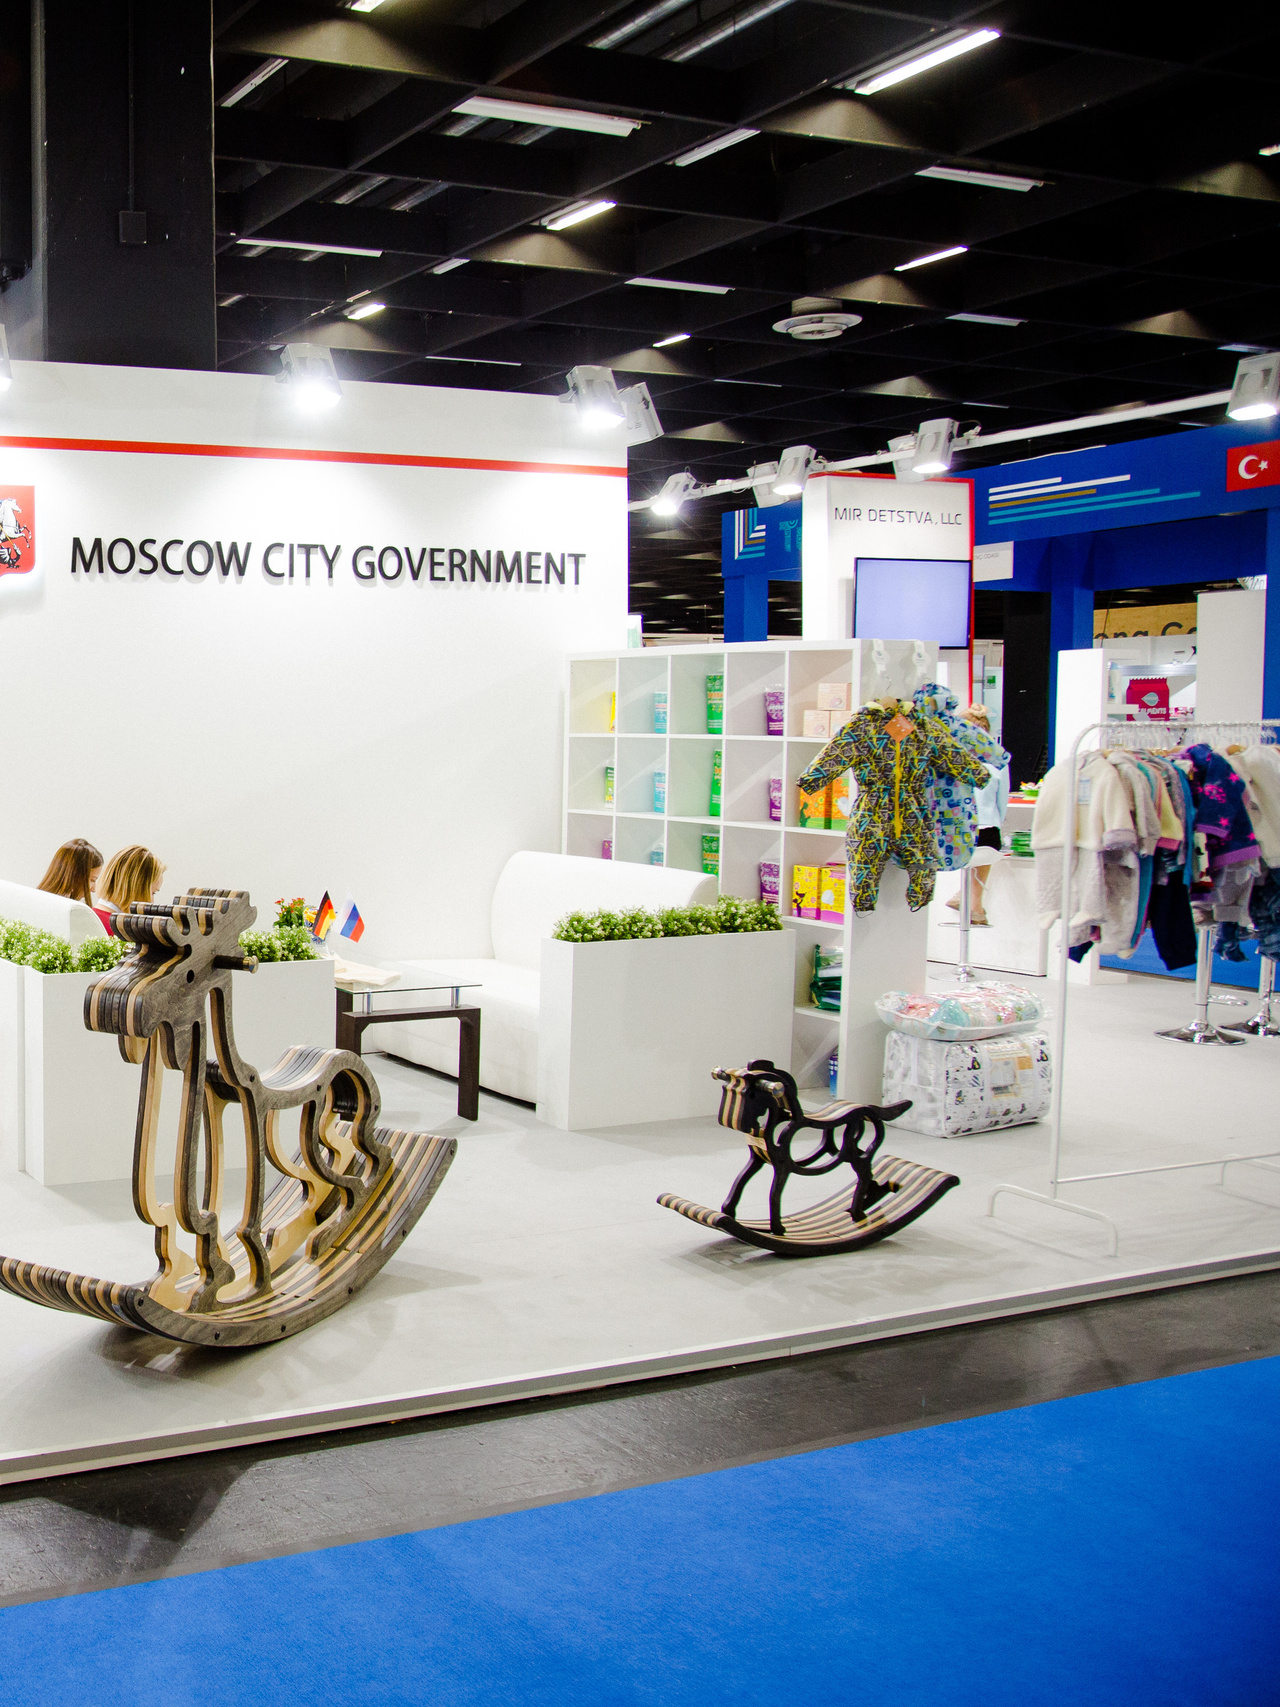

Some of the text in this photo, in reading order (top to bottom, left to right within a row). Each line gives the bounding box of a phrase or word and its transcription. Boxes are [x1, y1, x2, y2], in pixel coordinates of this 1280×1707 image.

[834, 507, 962, 525] MIR DETSTVA, LLC
[71, 537, 587, 585] MOSCOW CITY GOVERNMENT
